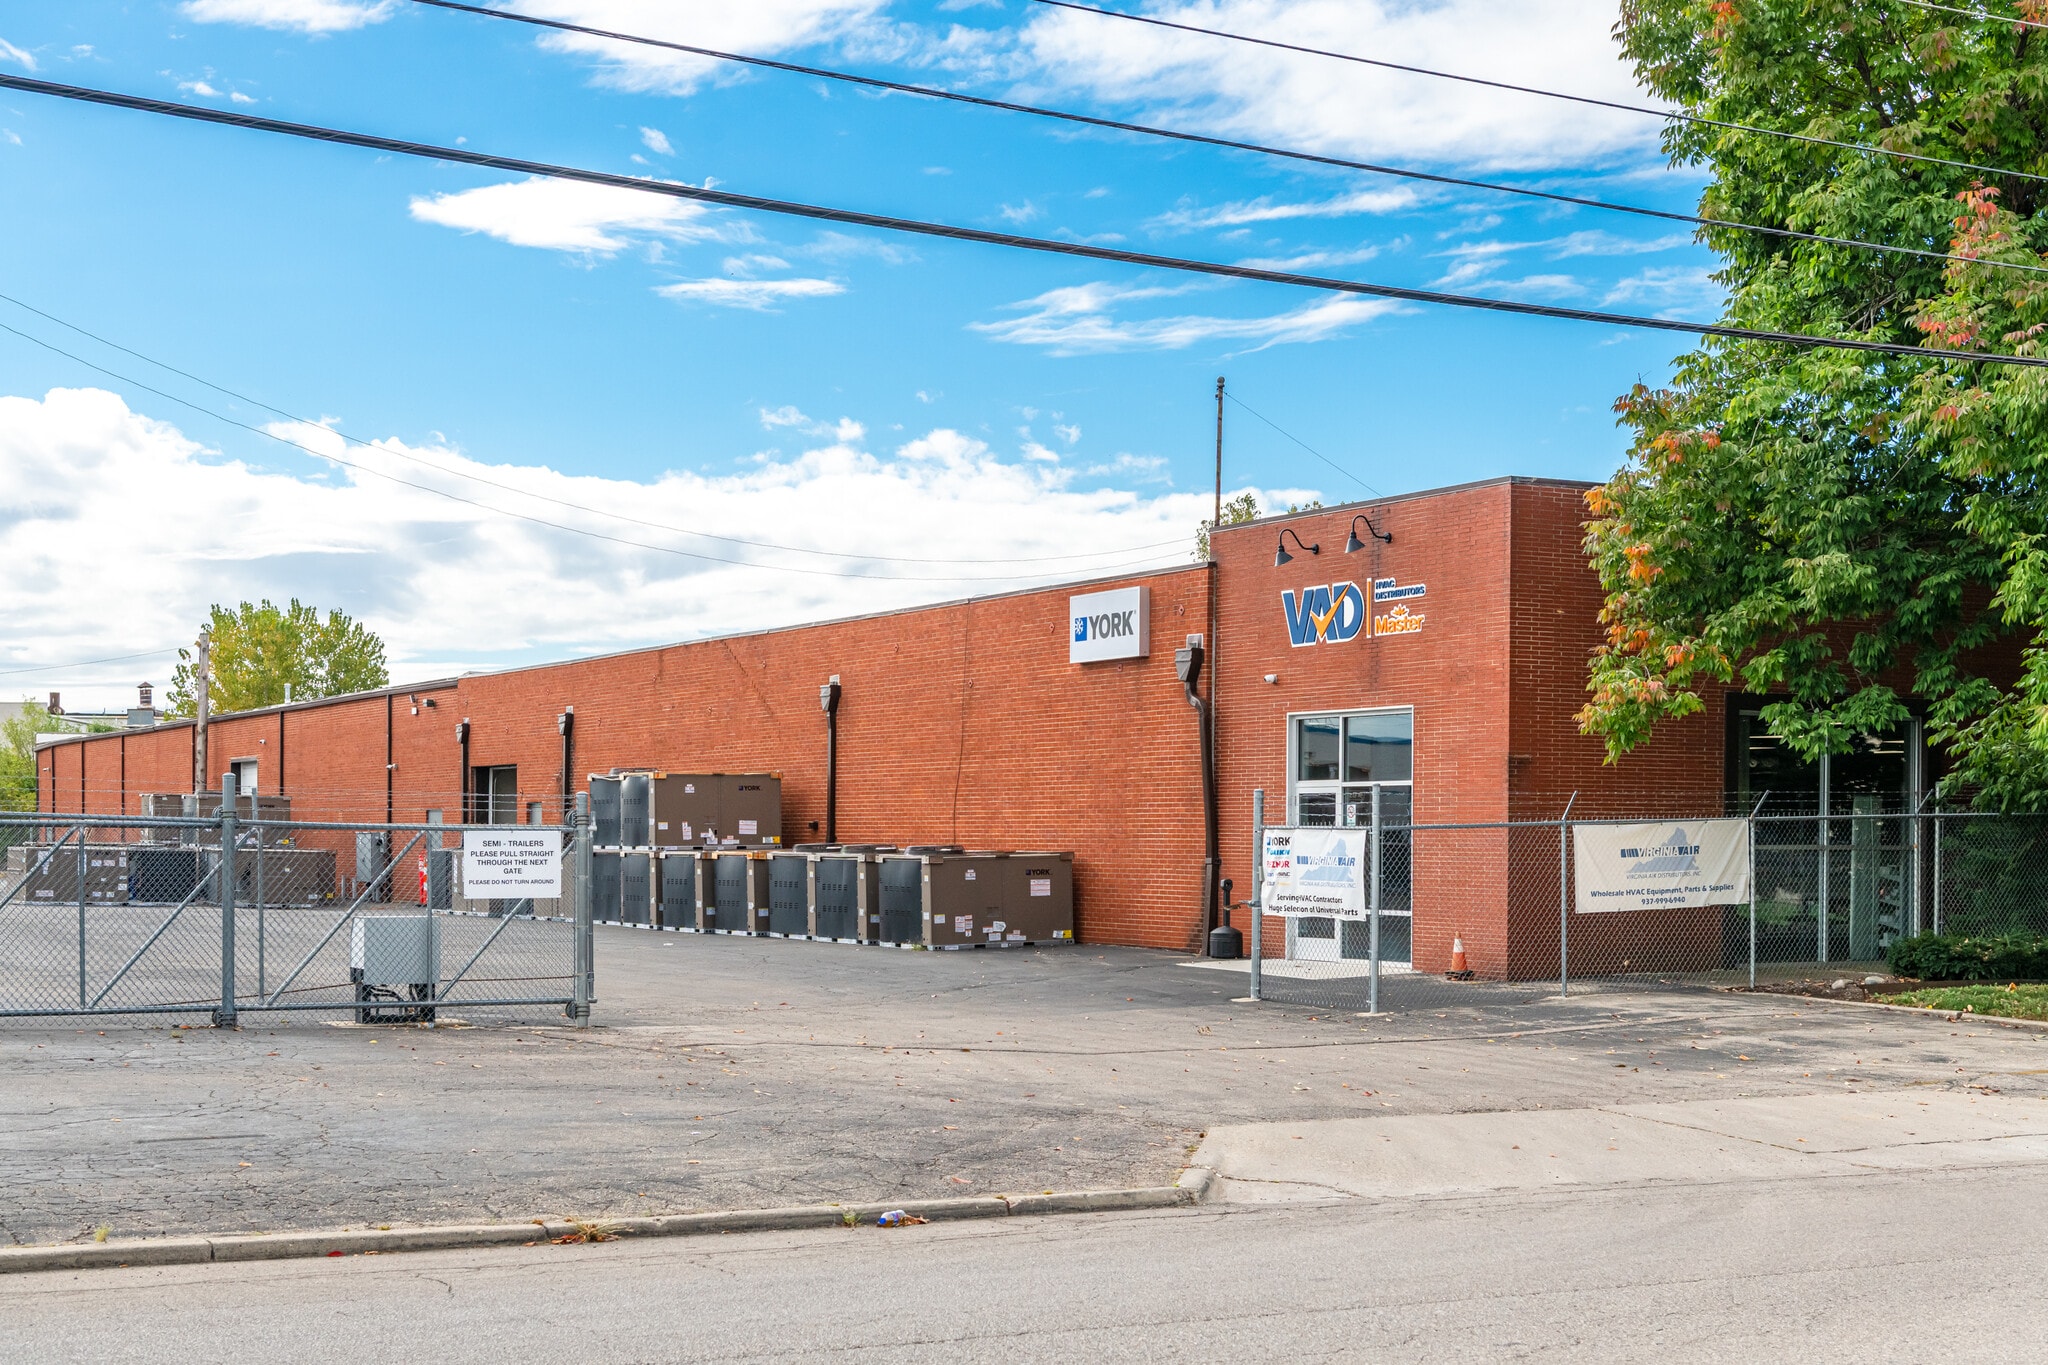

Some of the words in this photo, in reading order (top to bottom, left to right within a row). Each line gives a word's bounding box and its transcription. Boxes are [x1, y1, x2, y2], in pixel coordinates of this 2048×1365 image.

[1375, 579, 1395, 590] HVAC
[1375, 586, 1425, 600] DISTRIBUTORS
[1281, 581, 1364, 646] VAD
[1088, 610, 1134, 640] YORK
[1375, 615, 1425, 634] Master
[503, 867, 522, 875] GATE
[1590, 889, 1624, 898] Wholesale
[1625, 888, 1645, 896] HVAC
[1646, 887, 1683, 896] Equipment,
[1684, 885, 1701, 894] Parts
[1708, 883, 1735, 893] Supplies
[1276, 893, 1300, 903] Serving
[1312, 895, 1343, 904] Contractors
[1268, 904, 1283, 913] Huge
